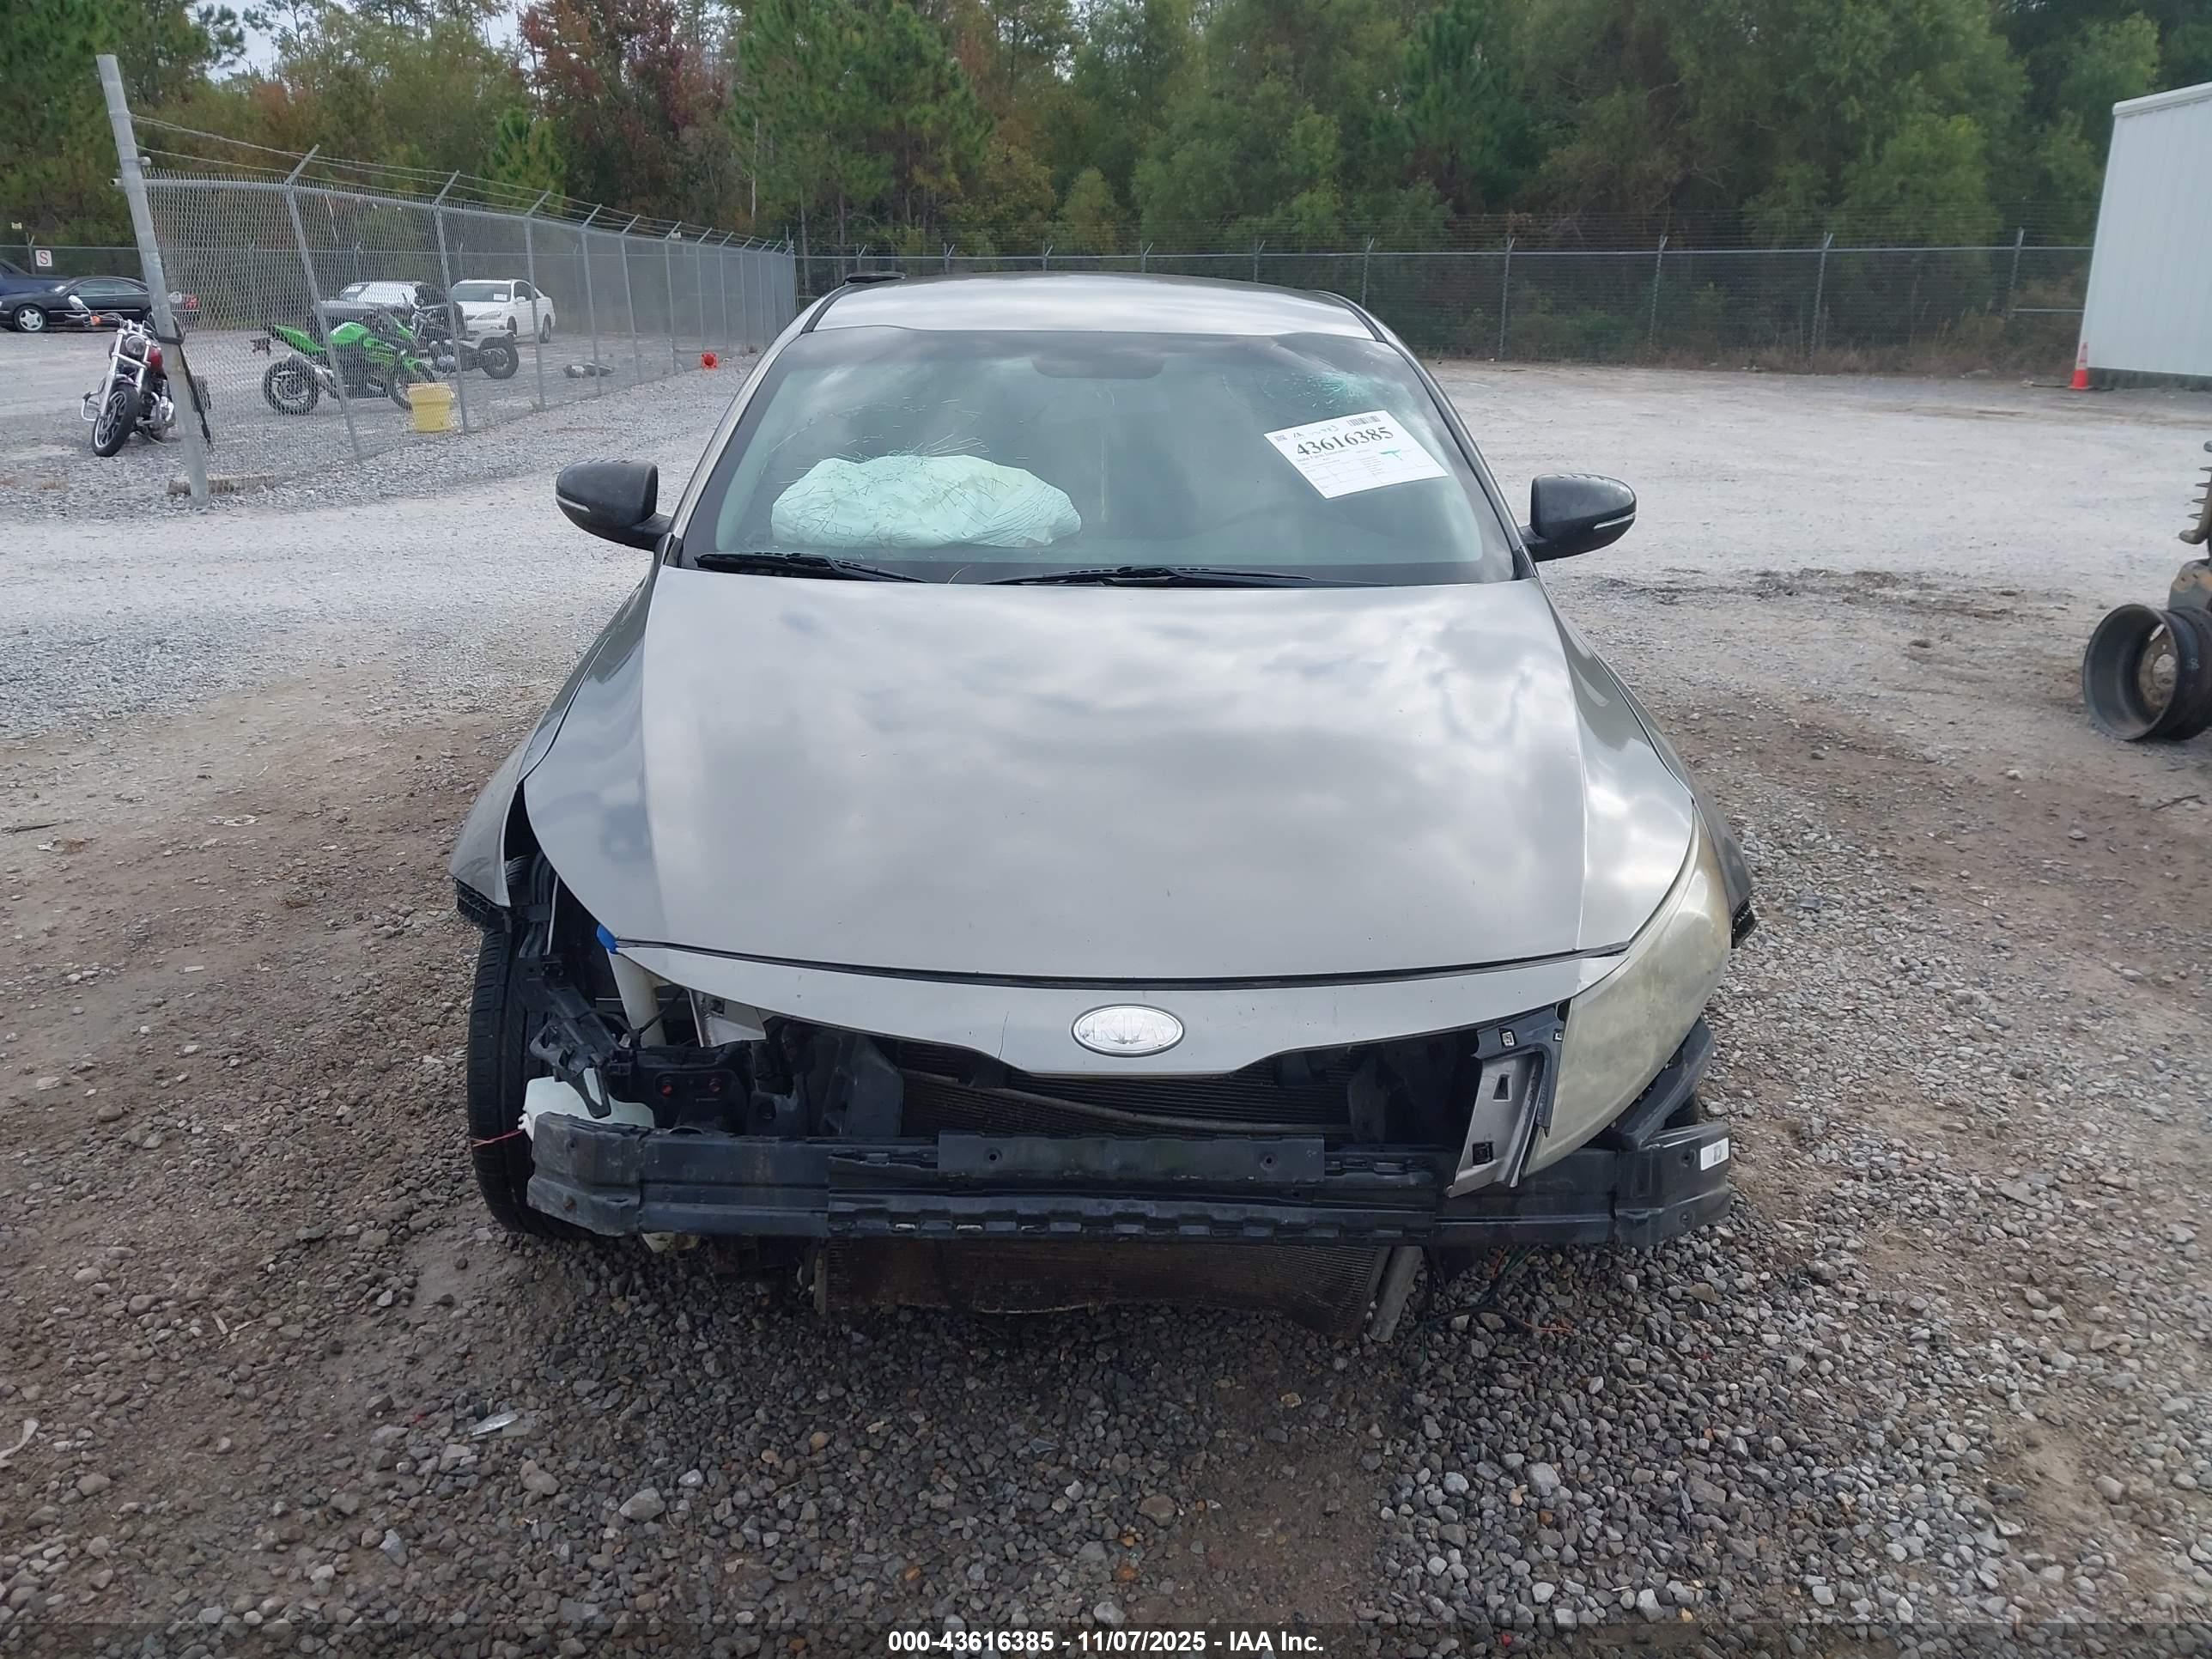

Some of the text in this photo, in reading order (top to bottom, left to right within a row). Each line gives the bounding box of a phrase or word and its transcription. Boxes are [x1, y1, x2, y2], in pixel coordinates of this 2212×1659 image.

[40, 252, 49, 264] S
[1297, 426, 1394, 456] 43616385
[1092, 1015, 1166, 1042] KIA
